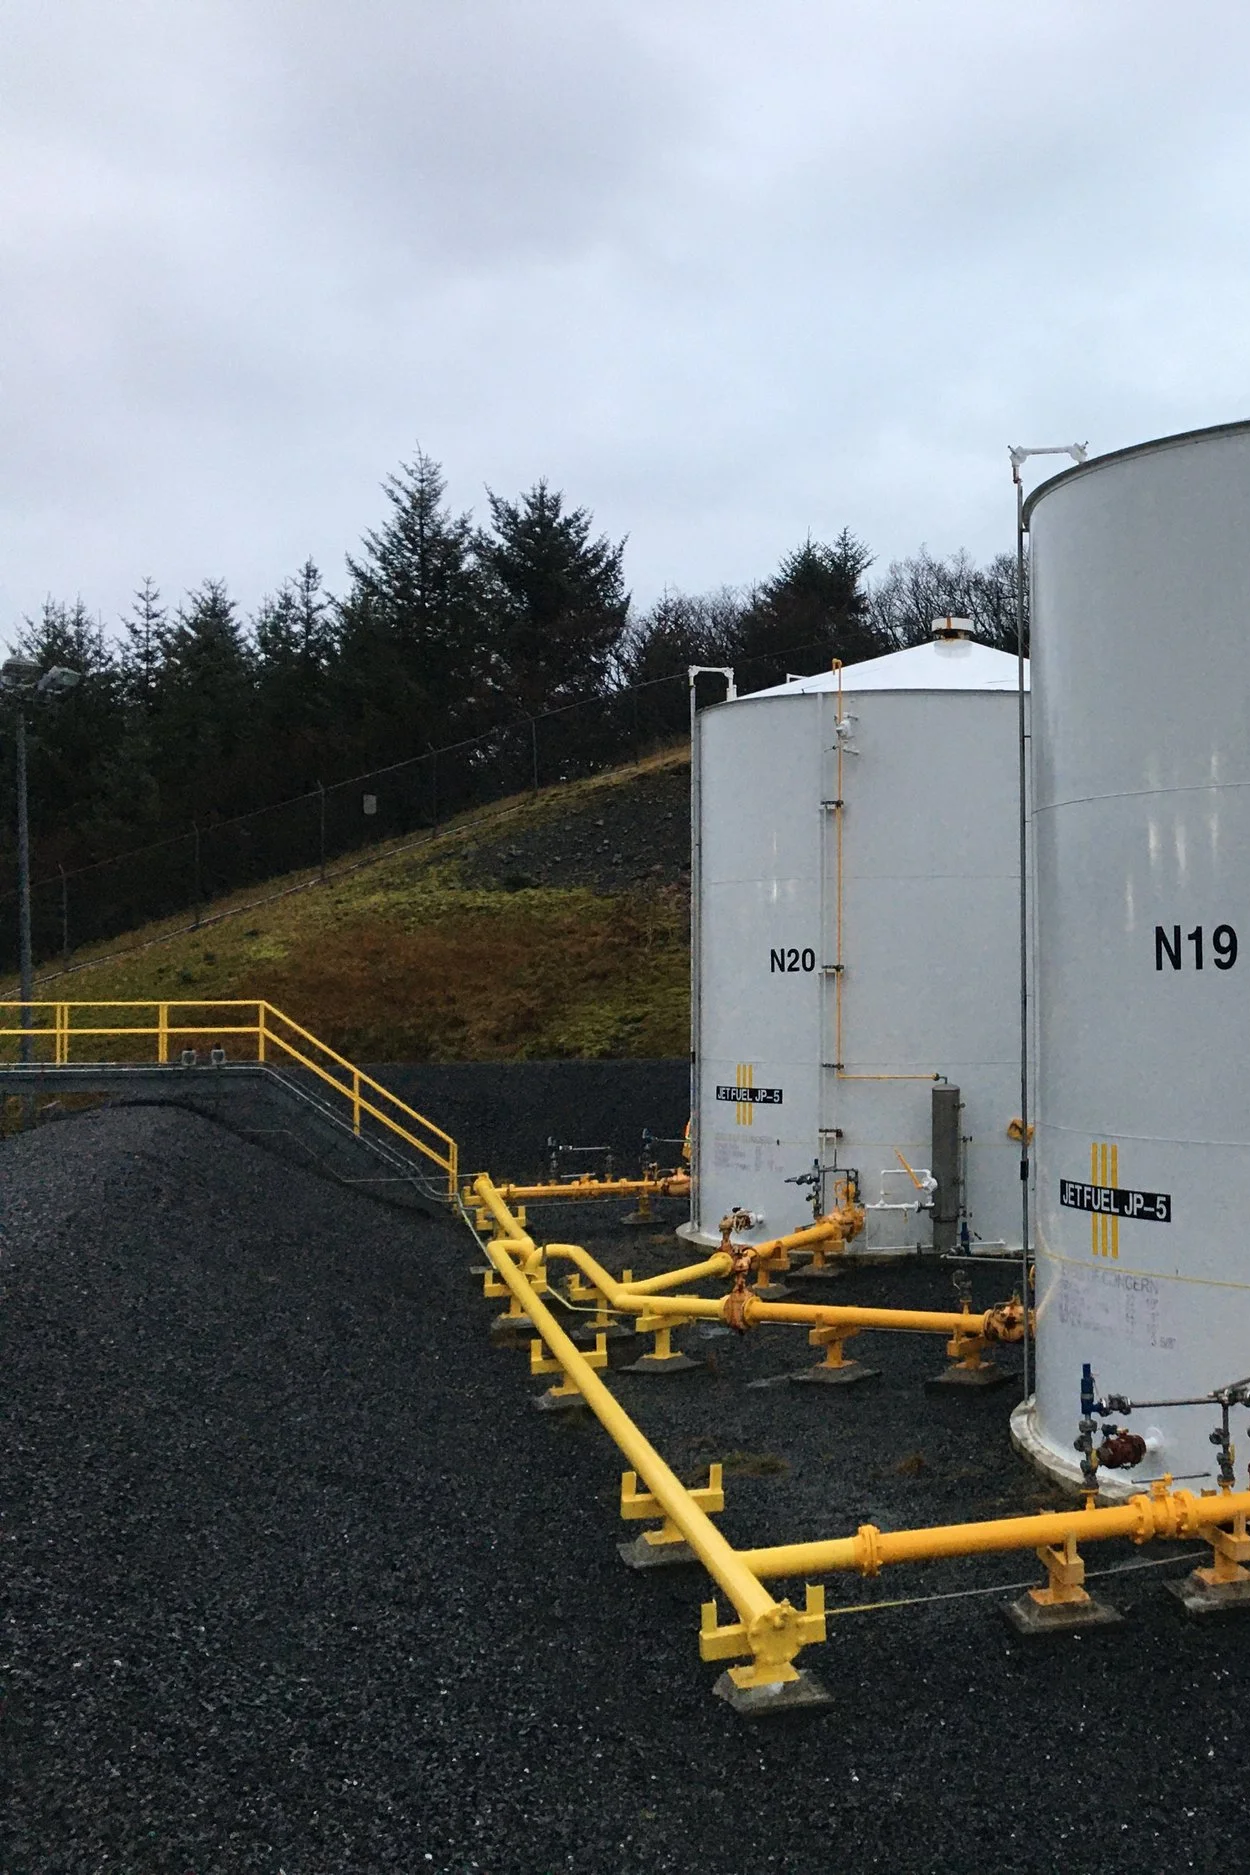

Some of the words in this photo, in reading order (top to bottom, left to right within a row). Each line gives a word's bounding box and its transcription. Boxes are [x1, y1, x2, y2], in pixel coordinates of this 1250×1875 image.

[770, 948, 815, 972] N20
[1155, 924, 1238, 970] N19
[718, 1088, 730, 1100] JET
[731, 1089, 753, 1101] FUEL
[755, 1090, 780, 1102] JP-5
[1063, 1182, 1082, 1207] JET
[1083, 1186, 1119, 1213] FUEL
[1124, 1192, 1167, 1219] JP-5
